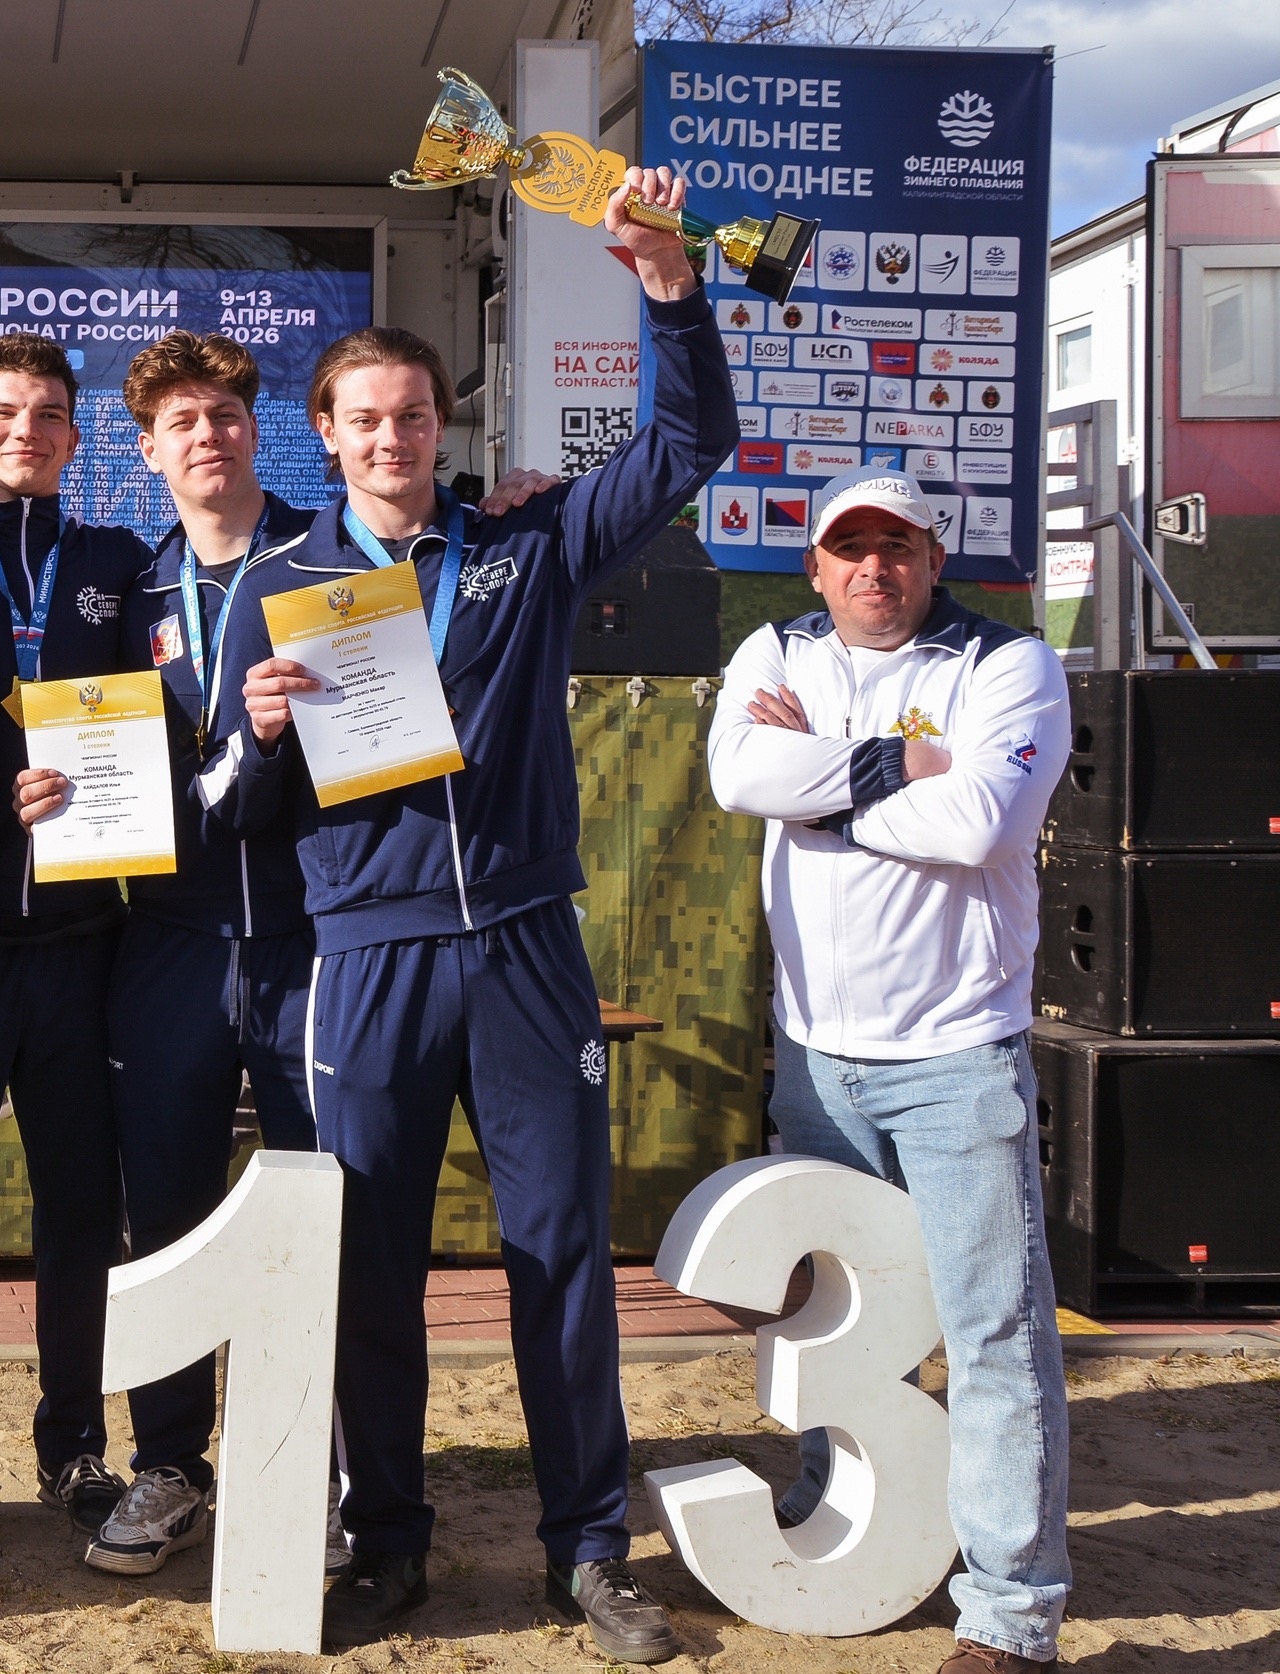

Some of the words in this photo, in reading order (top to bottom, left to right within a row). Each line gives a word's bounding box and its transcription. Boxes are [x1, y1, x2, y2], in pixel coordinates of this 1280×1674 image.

[670, 71, 841, 108] БЫСТРЕЕ
[670, 115, 842, 151] СИЛЬНЕЕ
[903, 155, 1024, 177] ФЕДЕРАЦИЯ
[577, 159, 608, 213] МИНСПОРТ
[670, 158, 874, 200] ХОЛОДНЕЕ
[903, 175, 958, 187] ЗИМНЕГО
[960, 177, 1023, 189] ПЛАВАНИЯ
[591, 169, 616, 211] РОССИИ
[902, 190, 983, 200] КАЛИНИНГРАДСКОЙ
[0, 287, 178, 318] РОССИИ
[220, 289, 272, 307] 9-13
[220, 308, 316, 326] АПРЕЛЯ
[844, 315, 913, 328] Ростелеком
[220, 327, 280, 344] 2026
[555, 341, 579, 351] ВСЯ
[582, 341, 639, 351] ИНФОРМ
[754, 342, 788, 356] БФУ
[555, 356, 588, 373] НА
[595, 353, 639, 374] САЙ
[555, 377, 639, 388] CONTRACT.M
[875, 421, 945, 437] NEPARKA
[969, 423, 1004, 436] БФУ
[38, 544, 57, 604] МИНИСТЕРСТ
[481, 566, 508, 582] СЕВЕРЕ
[483, 576, 510, 591] СПОРТ
[97, 601, 118, 610] СЕВЕРЕ
[331, 630, 371, 650] ДИПЛОМ
[343, 645, 369, 656] степени
[326, 678, 368, 694] Мурманская
[368, 670, 396, 682] область
[341, 667, 377, 682] КОМАНДА
[77, 729, 115, 741] ДИПЛОМ
[69, 772, 107, 781] Мурманская
[108, 770, 133, 778] область
[84, 764, 117, 773] КОМАНДА
[101, 1150, 344, 1654] 1
[644, 1153, 960, 1638] 3
